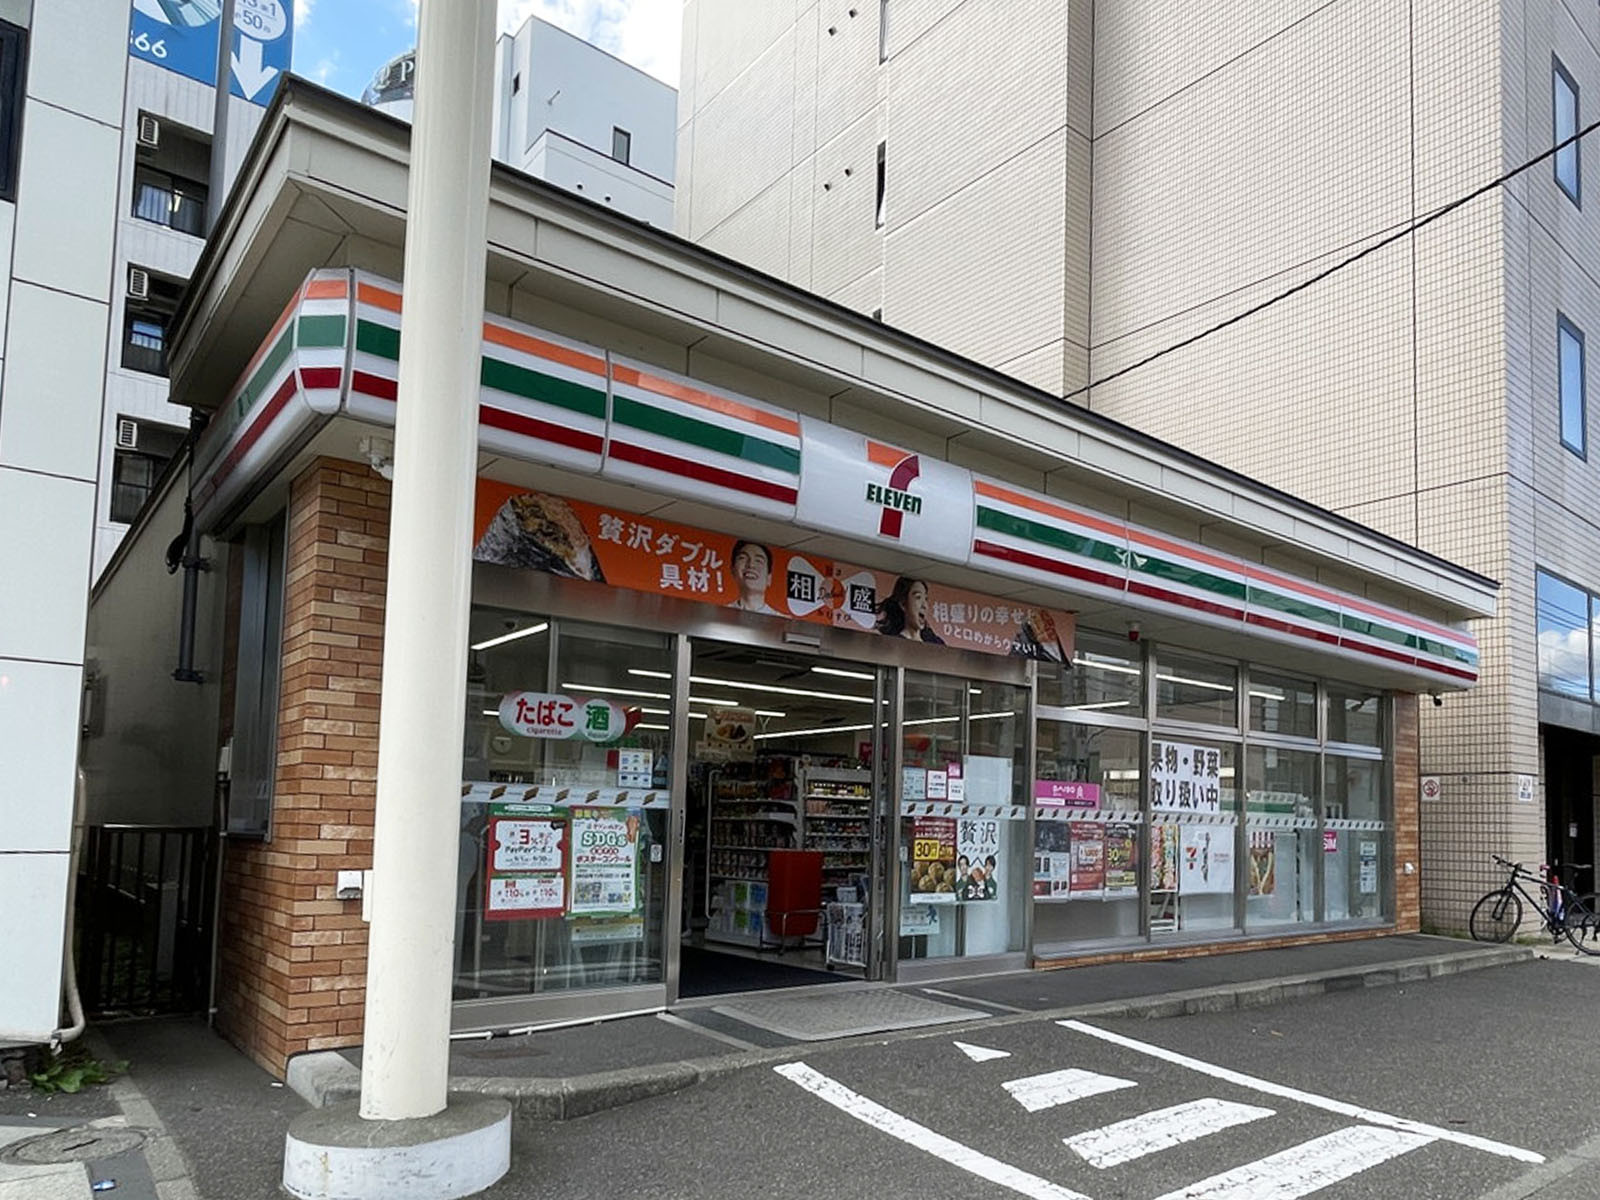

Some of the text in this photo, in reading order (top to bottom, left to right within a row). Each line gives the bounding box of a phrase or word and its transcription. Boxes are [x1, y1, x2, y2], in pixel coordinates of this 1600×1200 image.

[130, 30, 168, 59] 66
[598, 513, 724, 569] 贅沢ダブル
[516, 698, 575, 728] たばこ
[586, 704, 610, 731] 酒
[1151, 778, 1219, 812] 取り扱い中
[582, 830, 628, 847] SDGs
[960, 820, 996, 845] 贅沢
